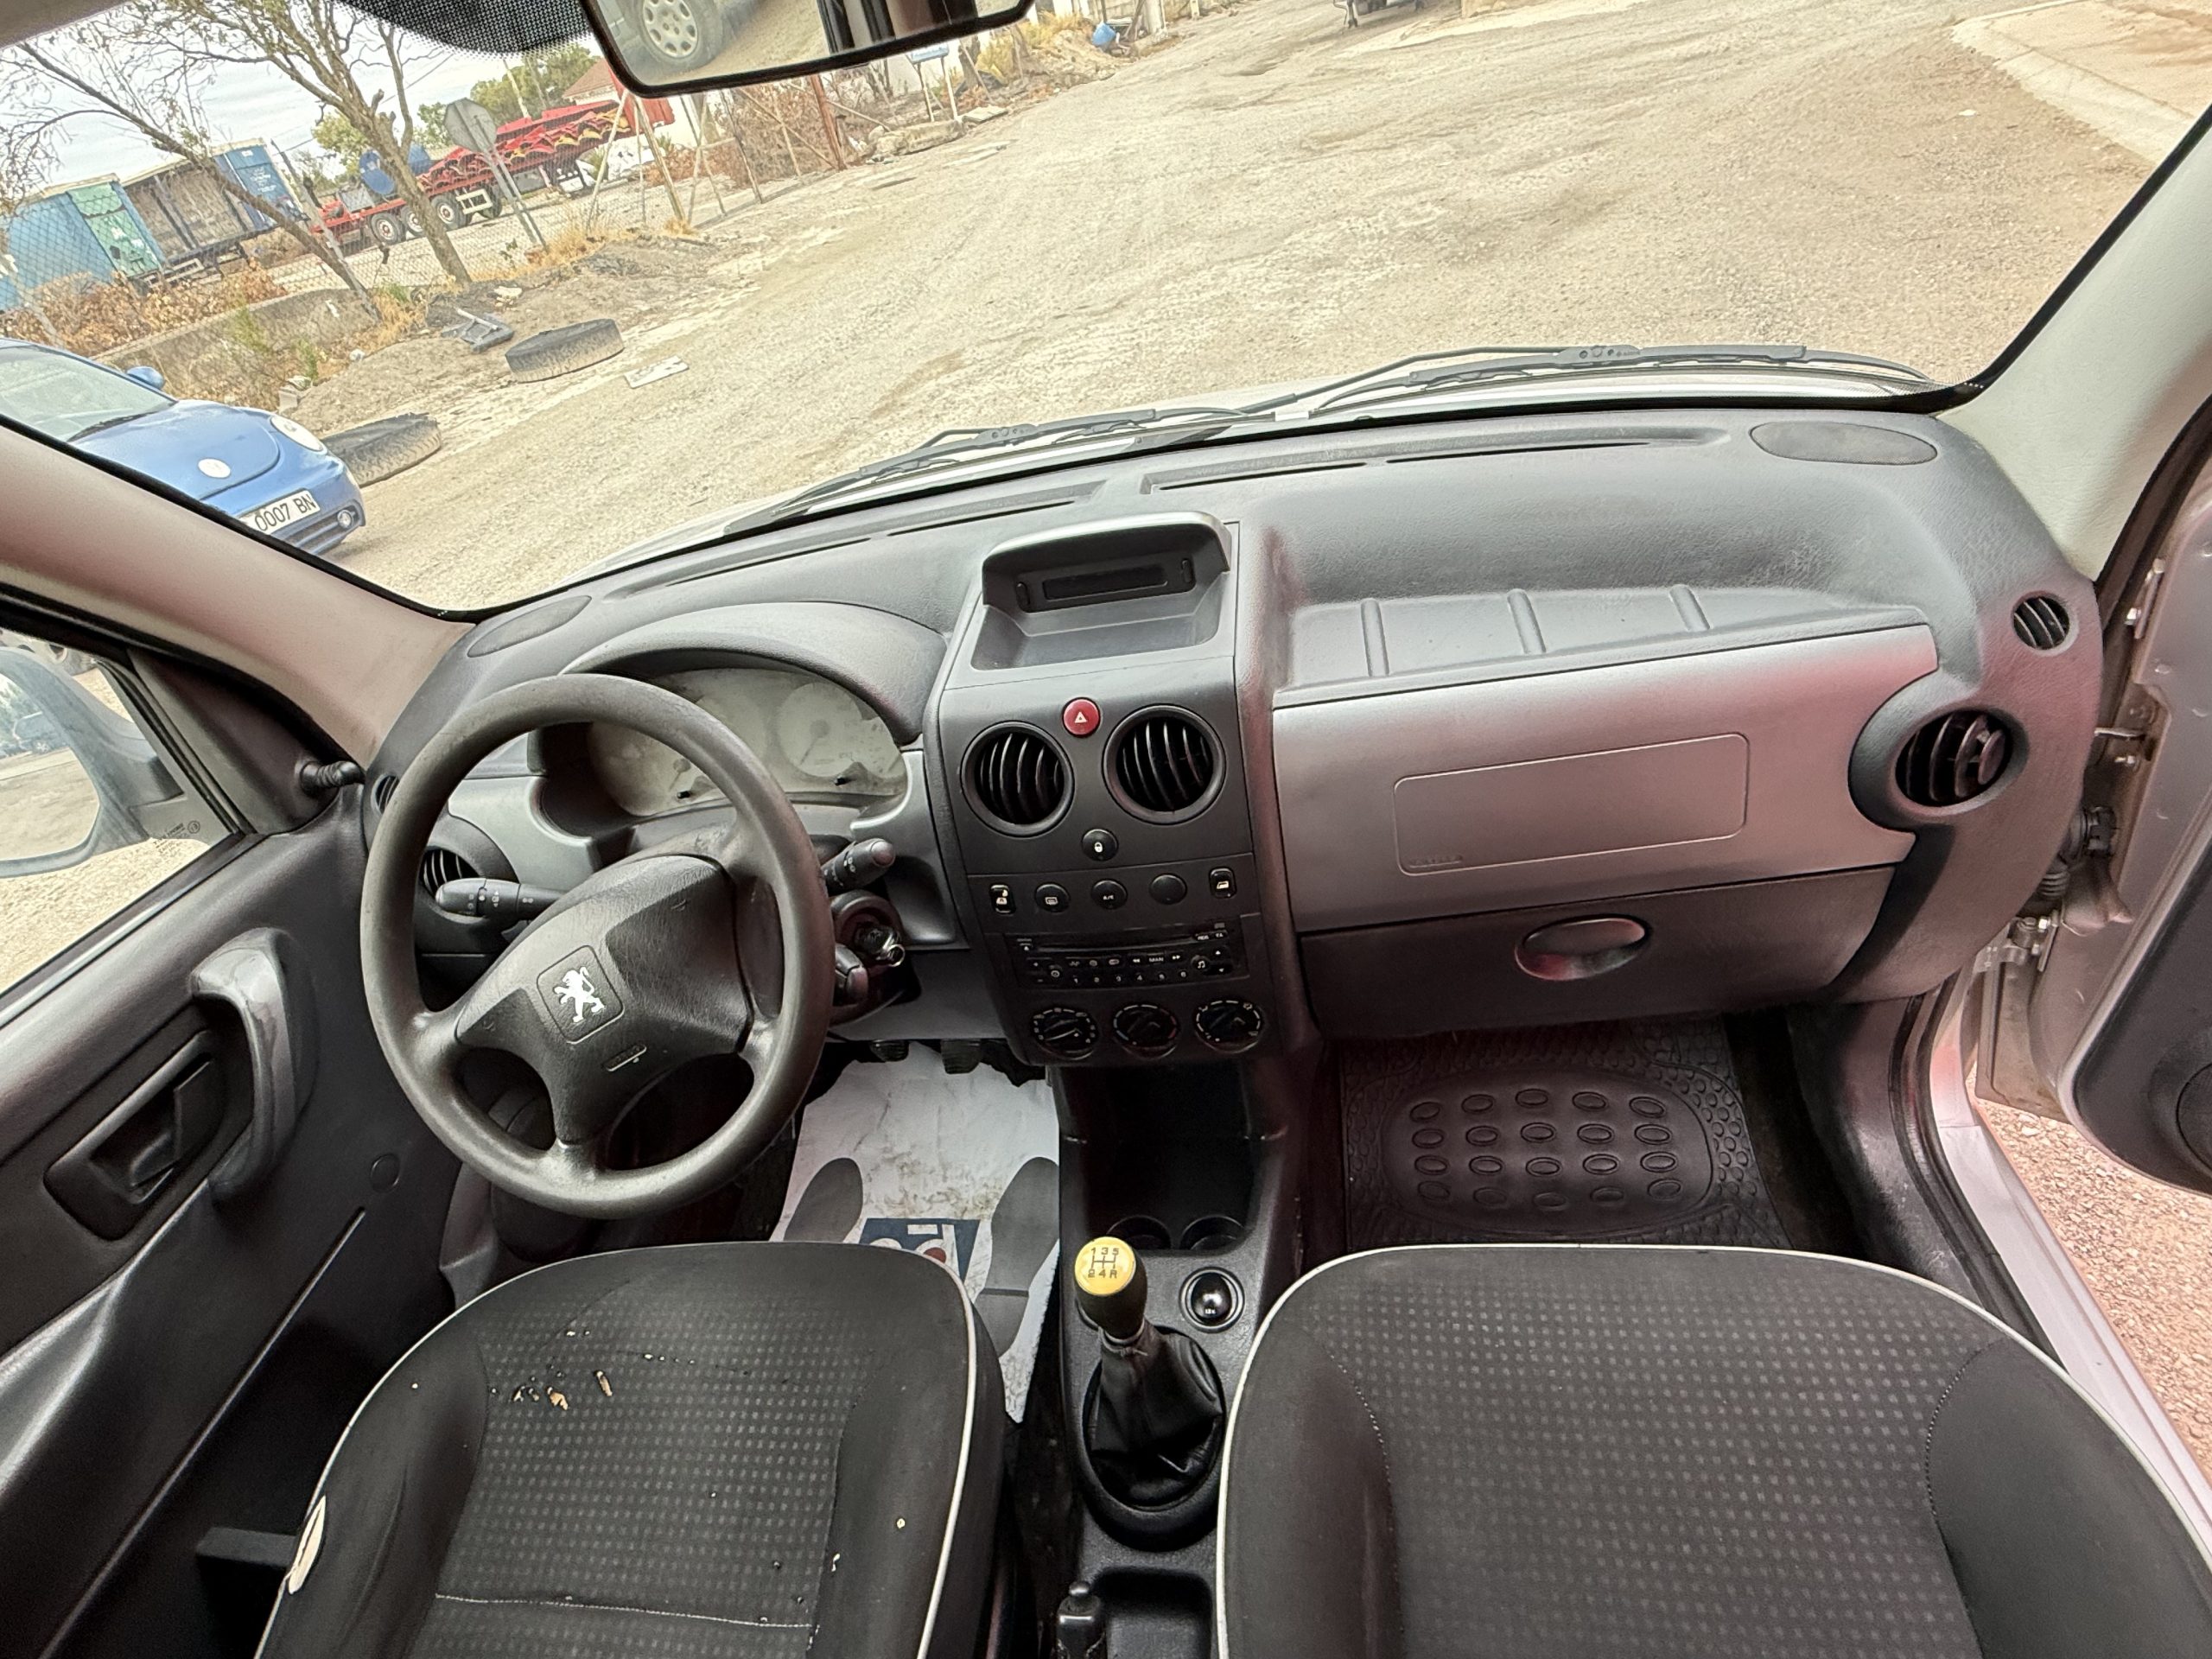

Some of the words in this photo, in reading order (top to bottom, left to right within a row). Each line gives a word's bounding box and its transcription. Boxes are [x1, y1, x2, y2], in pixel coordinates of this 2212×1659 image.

[254, 503, 290, 531] 0007
[292, 493, 316, 514] BN
[1101, 1247, 1109, 1255] 3
[1088, 1268, 1096, 1278] 2
[1098, 1268, 1106, 1279] 4
[1109, 1268, 1117, 1279] R
